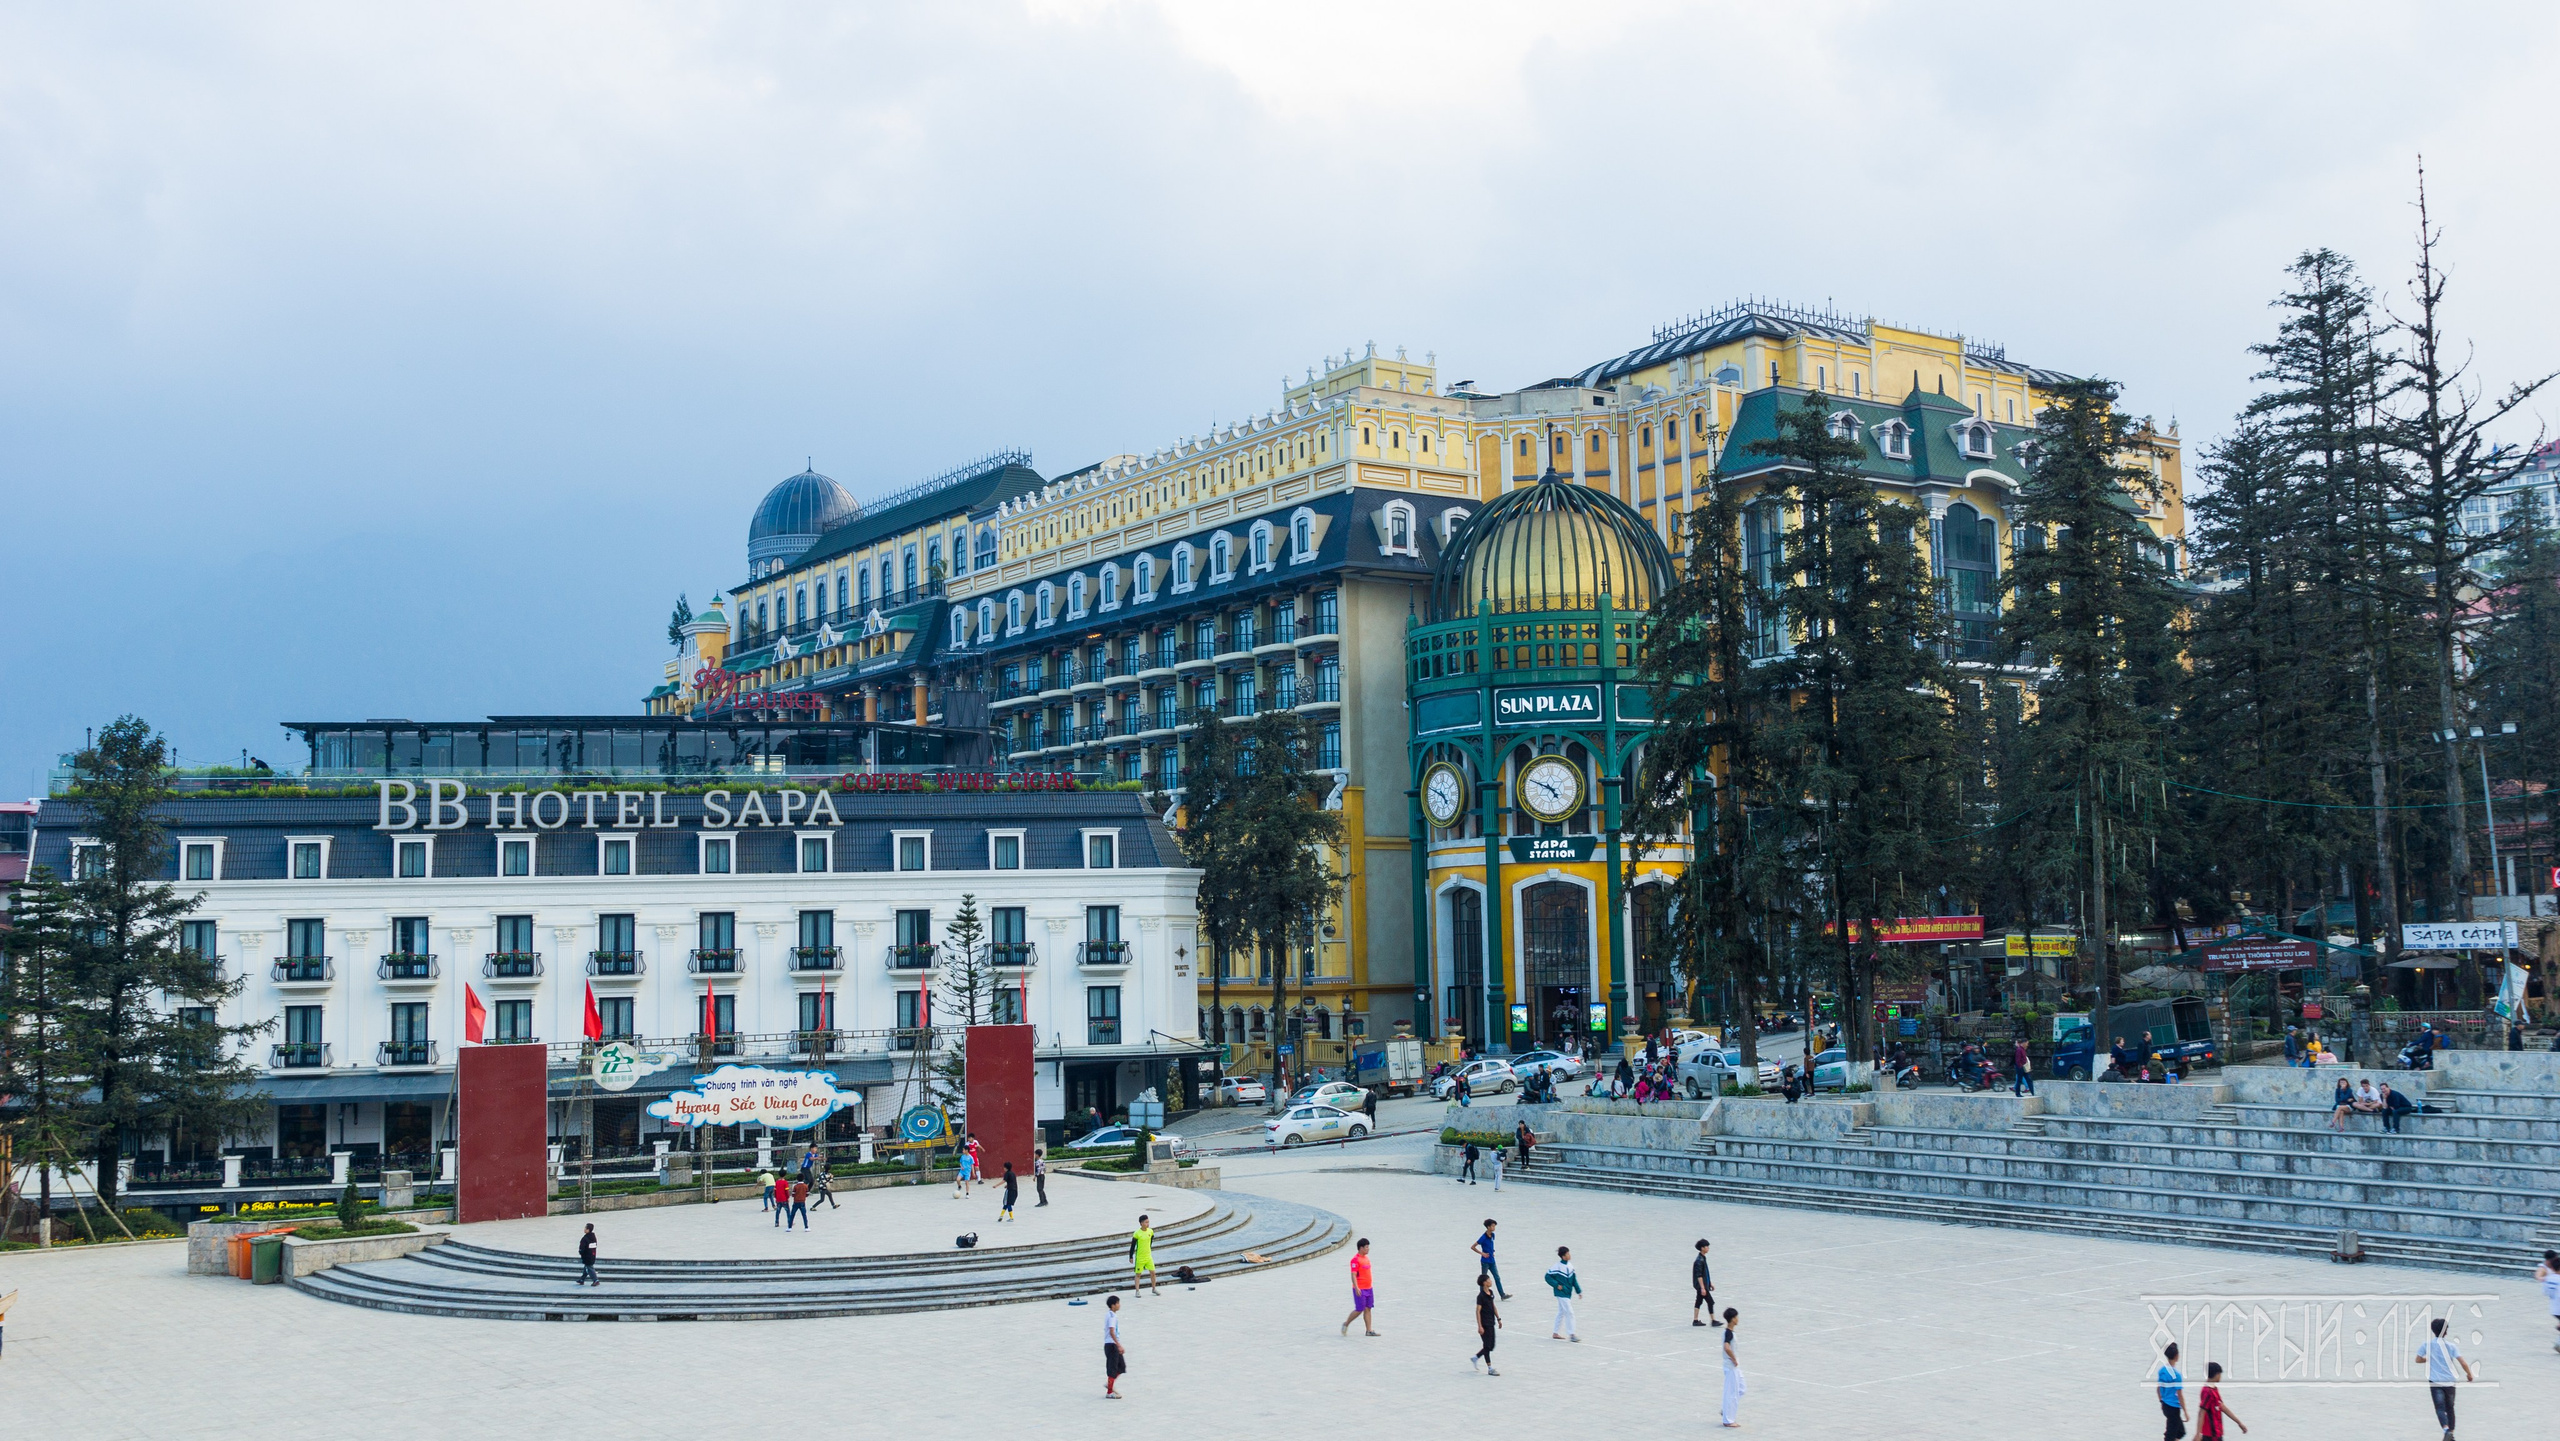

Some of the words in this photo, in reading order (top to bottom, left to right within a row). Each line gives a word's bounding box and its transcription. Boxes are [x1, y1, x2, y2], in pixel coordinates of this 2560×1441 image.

[733, 692, 823, 709] LOUNGE
[1500, 697, 1533, 714] SUN
[1536, 694, 1593, 712] PLAZA
[842, 773, 923, 790] COFFEE
[936, 773, 994, 790] WINE
[1007, 772, 1075, 790] CIGAR
[372, 779, 469, 831] BB
[485, 791, 679, 830] HOTEL
[702, 789, 844, 828] SAPA
[1533, 839, 1568, 849] SAPA
[1529, 849, 1575, 859] STATION
[2412, 929, 2455, 941] SAPA
[2247, 951, 2271, 959] THÔNG
[705, 1081, 736, 1092] Chương
[741, 1079, 757, 1089] trình
[761, 1078, 775, 1088] văn
[779, 1077, 798, 1089] nghệ
[675, 1100, 720, 1116] Hương
[729, 1095, 757, 1112] Sắc
[763, 1095, 798, 1112] Vùng
[802, 1094, 828, 1107] Cao
